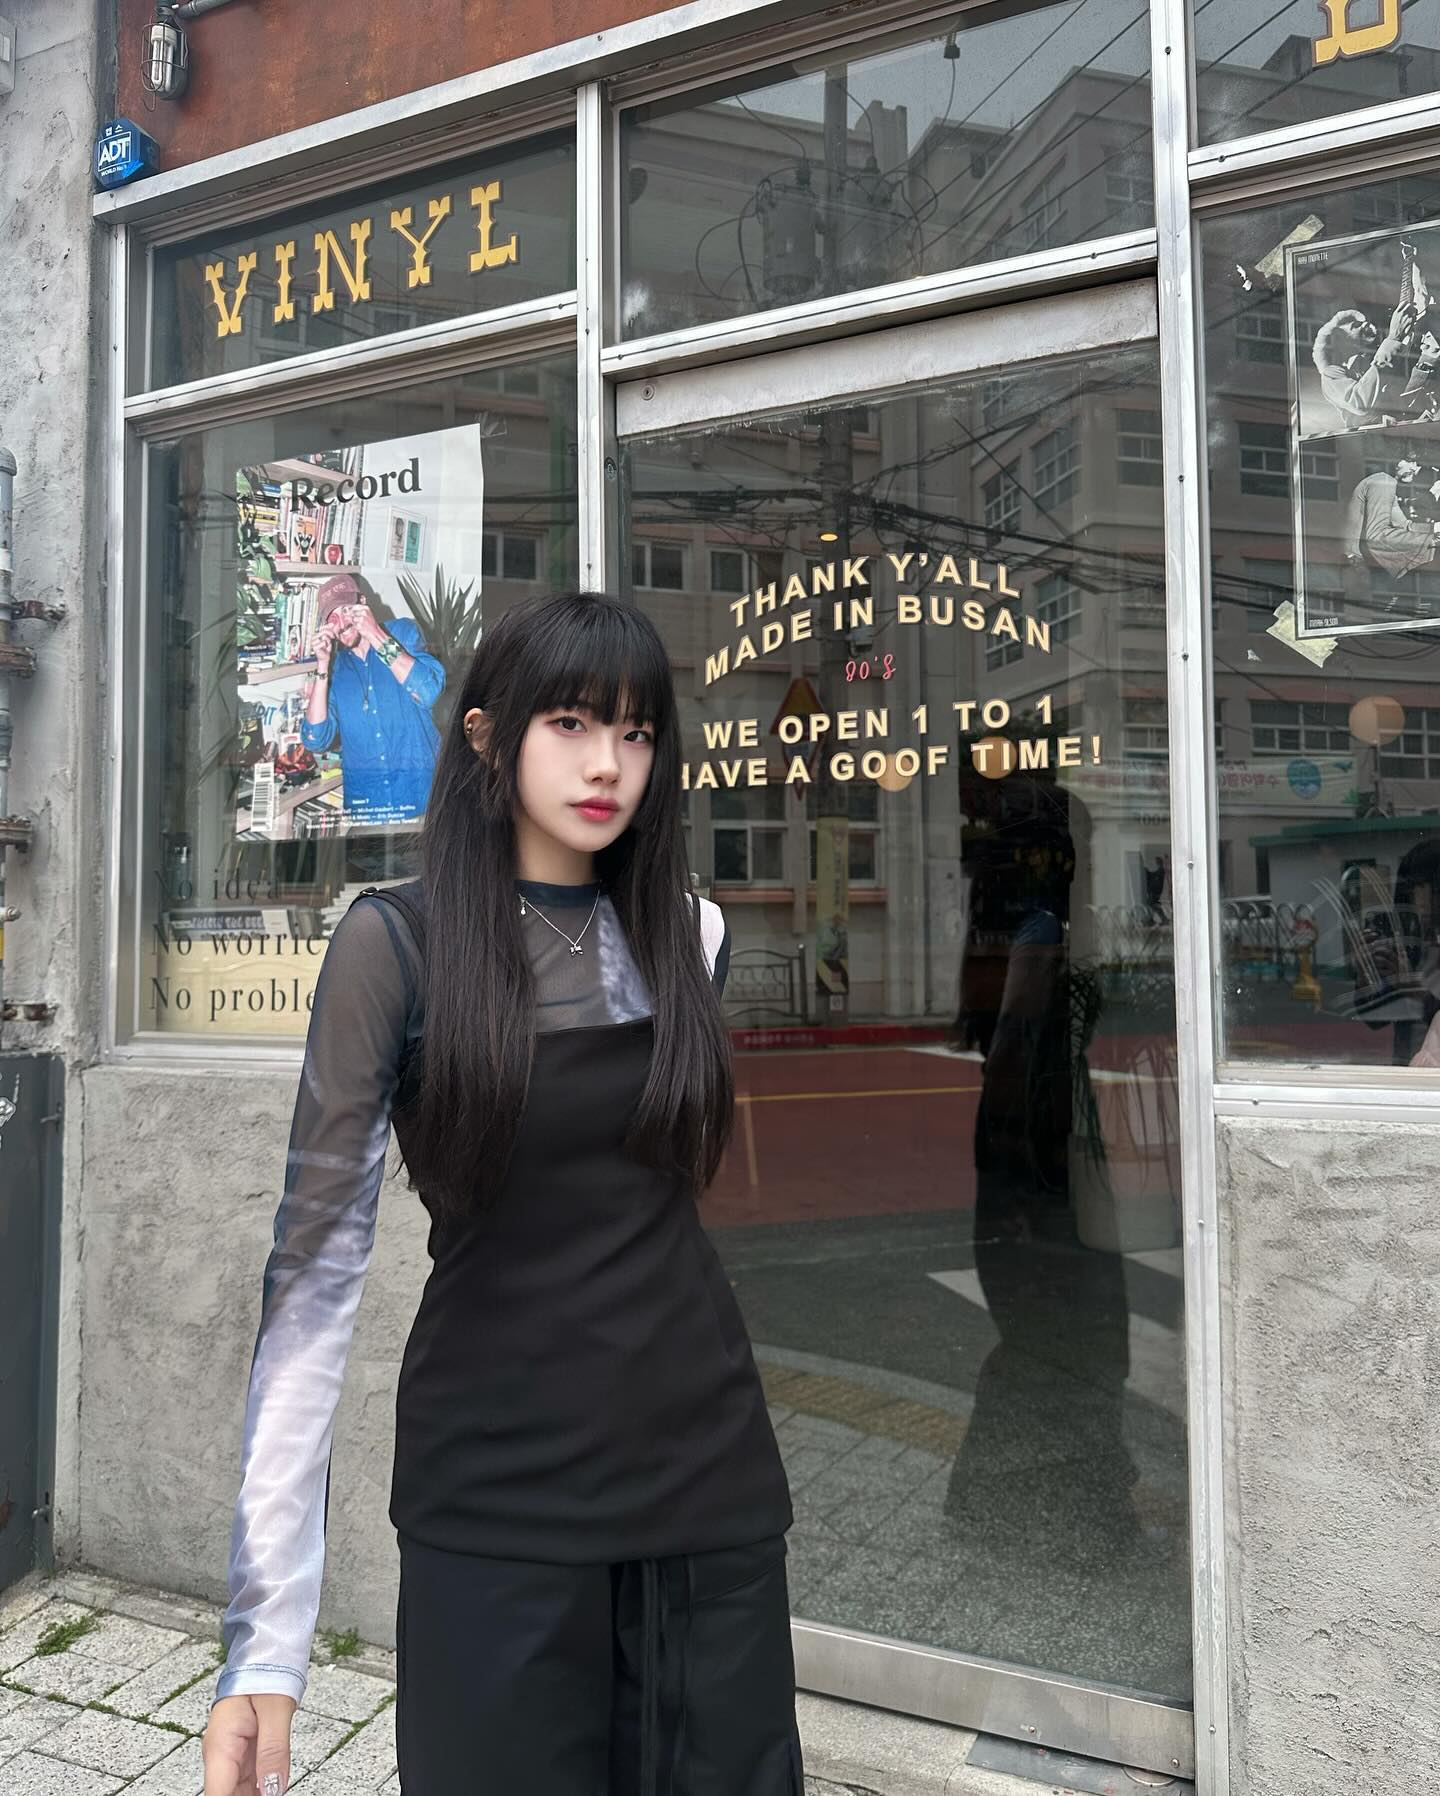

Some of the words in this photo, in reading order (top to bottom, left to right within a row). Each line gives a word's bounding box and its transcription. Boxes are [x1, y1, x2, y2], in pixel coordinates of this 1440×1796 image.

[98, 136, 131, 167] ADT
[204, 181, 517, 338] VINYL
[290, 456, 422, 513] Record
[729, 555, 870, 629] THANK
[887, 552, 1021, 599] Y’ALL
[704, 608, 812, 686] MADE
[833, 596, 874, 632] IN
[897, 594, 1051, 655] BUSAN
[702, 718, 759, 750] WE
[778, 708, 889, 745] OPEN
[911, 705, 929, 735] 1
[952, 697, 1010, 731] TO
[1035, 694, 1053, 725] 1
[784, 754, 812, 785] A
[829, 745, 949, 782] GOOF
[970, 736, 1101, 772] TIME!
[153, 869, 193, 901] No
[152, 922, 193, 956] No
[149, 976, 191, 1010] No
